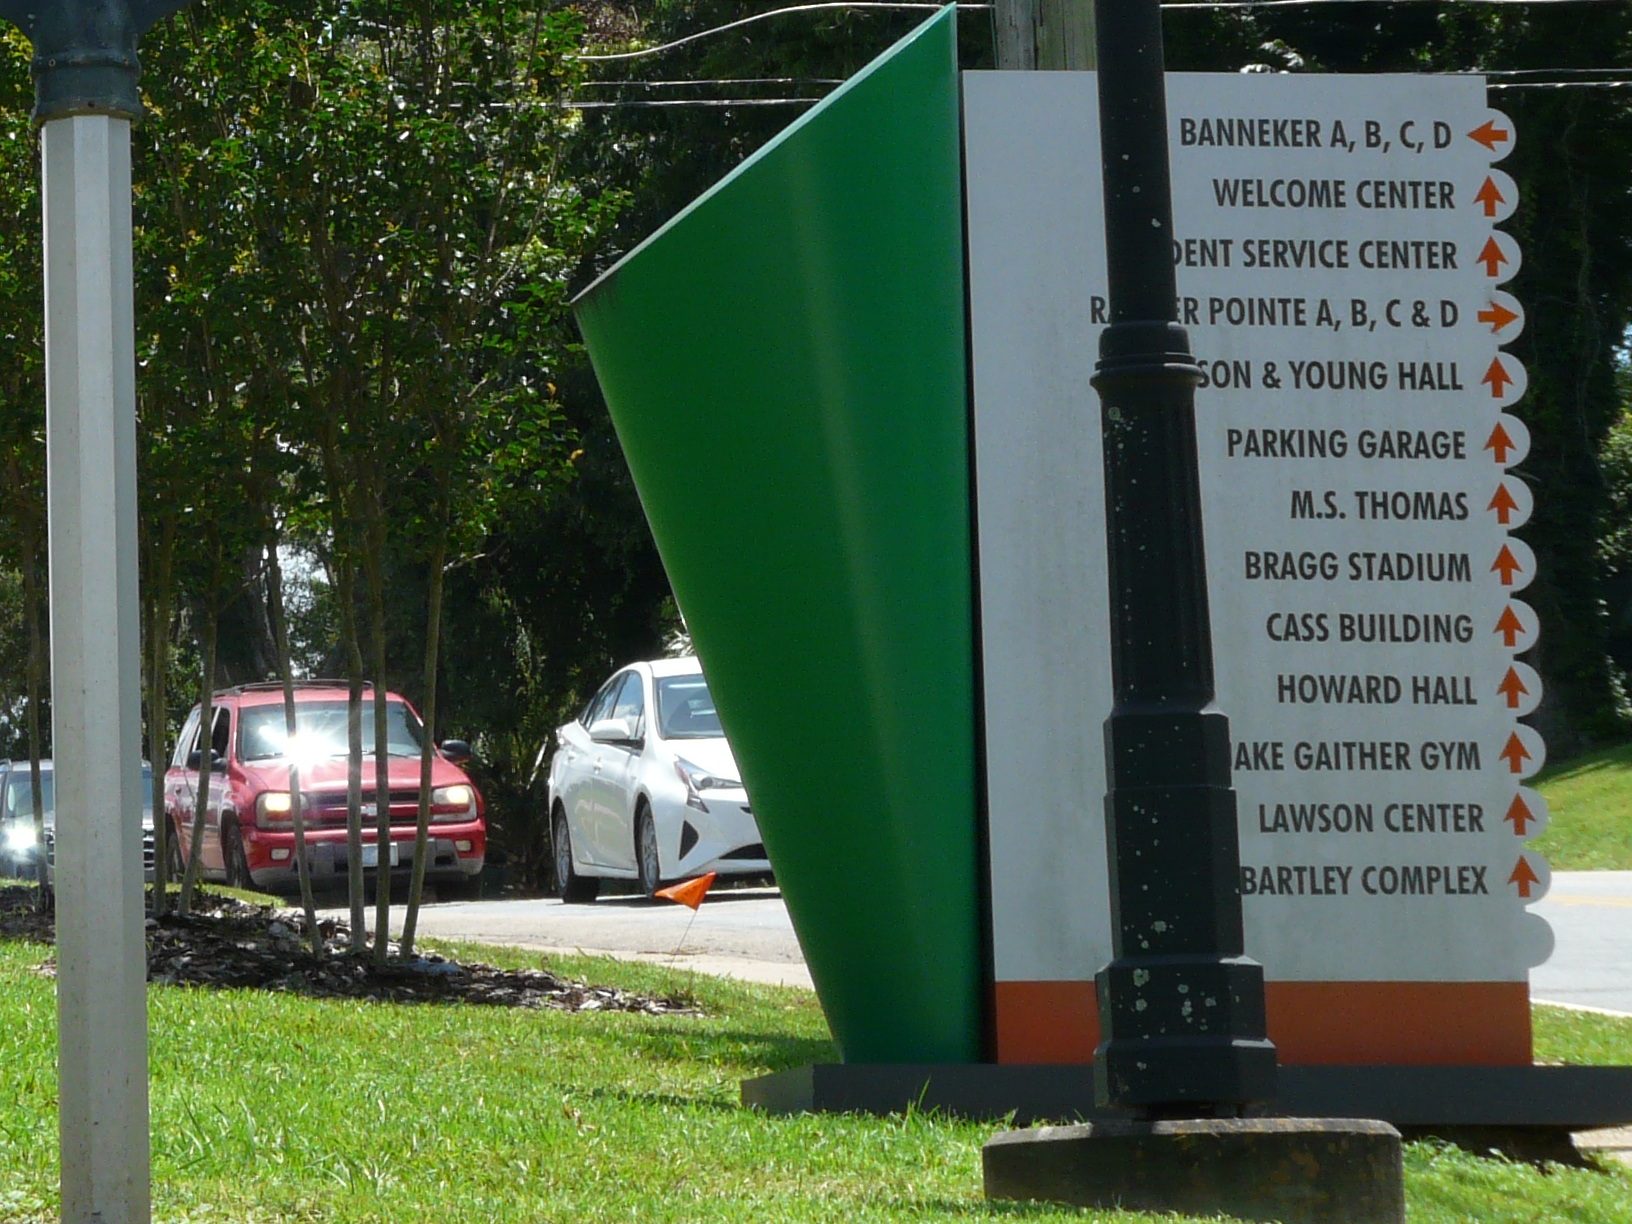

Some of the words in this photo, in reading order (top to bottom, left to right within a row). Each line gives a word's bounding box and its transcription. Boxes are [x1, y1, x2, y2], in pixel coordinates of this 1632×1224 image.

[1180, 118, 1321, 148] BANNEKER
[1330, 120, 1355, 153] A,
[1365, 120, 1390, 153] B,
[1400, 121, 1424, 153] C,
[1434, 122, 1452, 149] D
[1213, 178, 1347, 208] WELCOME
[1356, 180, 1455, 209] CENTER
[1171, 239, 1233, 267] DENT
[1243, 240, 1349, 269] SERVICE
[1358, 241, 1457, 270] CENTER
[1210, 297, 1305, 326] POINTE
[1316, 299, 1340, 332] A,
[1352, 299, 1376, 332] B,
[1386, 299, 1401, 327] C
[1411, 300, 1431, 327] &
[1440, 300, 1459, 328] D
[1262, 361, 1282, 389] &
[1288, 361, 1388, 390] YOUNG
[1398, 362, 1463, 391] HALL
[1227, 428, 1348, 458] PARKING
[1358, 429, 1466, 460] GARAGE
[1290, 491, 1347, 520] M.S.
[1355, 491, 1468, 521] THOMAS
[1245, 551, 1339, 581] BRAGG
[1348, 552, 1472, 582] STADIUM
[1266, 613, 1329, 641] CASS
[1339, 614, 1474, 643] BUILDING
[1277, 675, 1401, 705] HOWARD
[1412, 676, 1477, 705] HALL
[1234, 741, 1284, 771] AKE
[1293, 741, 1410, 771] GAITHER
[1420, 741, 1481, 771] GYM
[1259, 804, 1373, 833] LAWSON
[1384, 804, 1484, 833] CENTER
[1240, 866, 1352, 895] BARTLEY
[1362, 866, 1488, 895] COMPLEX
